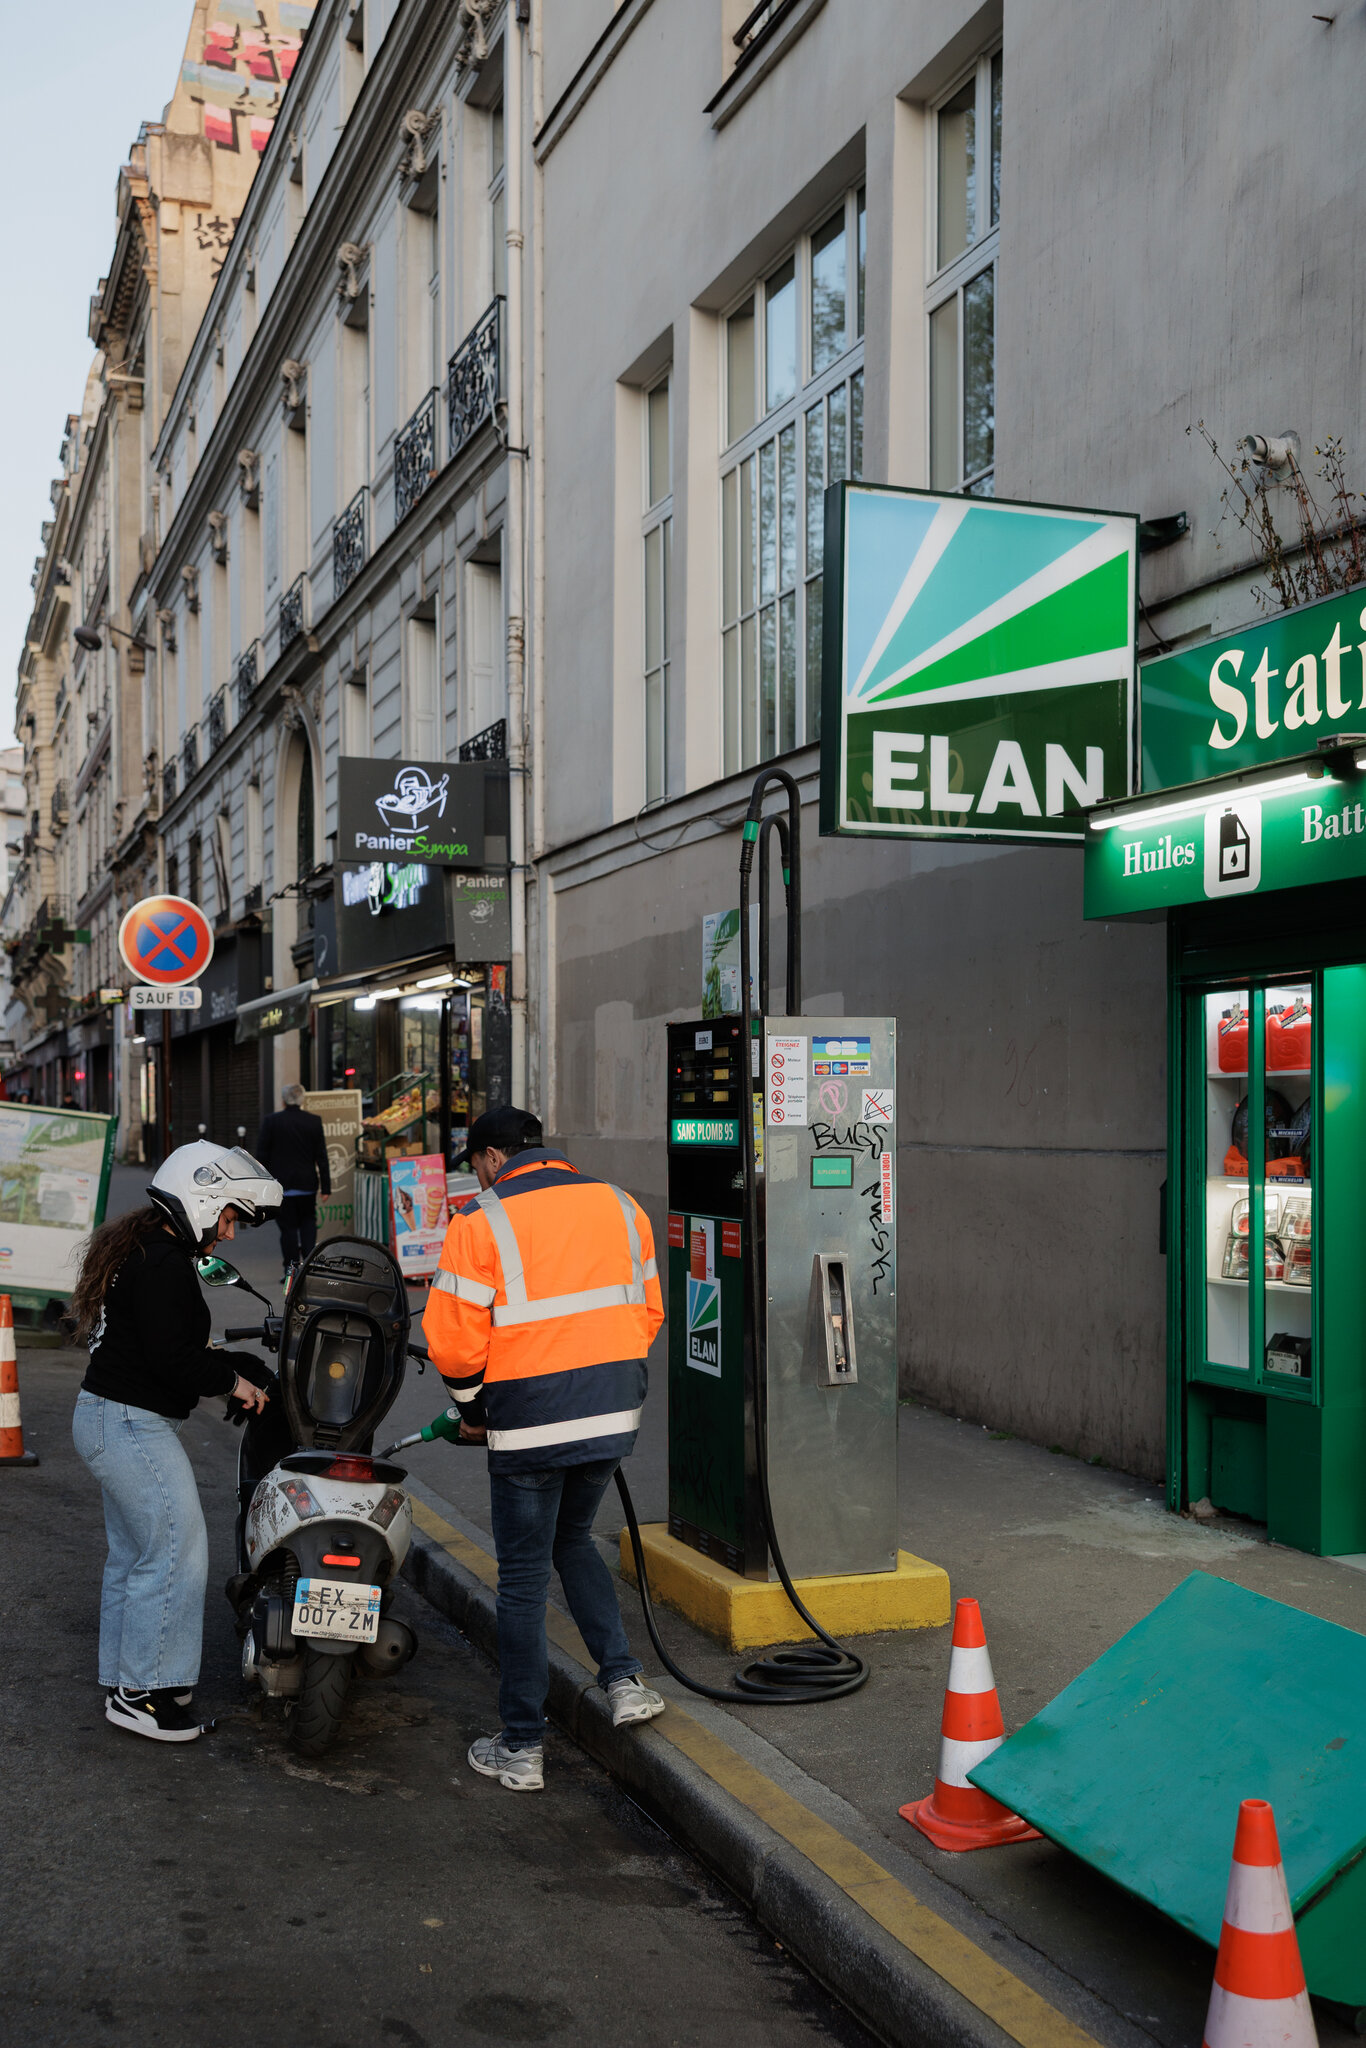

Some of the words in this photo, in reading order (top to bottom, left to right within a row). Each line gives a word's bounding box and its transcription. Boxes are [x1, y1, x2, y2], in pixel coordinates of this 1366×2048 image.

[873, 731, 1104, 818] ELAN
[1301, 802, 1366, 844] Batt
[1122, 835, 1196, 877] Huiles
[456, 874, 506, 889] Panier
[136, 992, 175, 1004] SAUF
[50, 1121, 79, 1142] ELAN
[677, 1123, 696, 1141] SANS
[697, 1123, 723, 1141] PLOMB
[724, 1123, 734, 1141] 95
[882, 1153, 890, 1171] FIORI
[882, 1181, 892, 1213] CADILLAC
[691, 1336, 716, 1363] ELAN
[298, 1606, 374, 1631] 007-ZM
